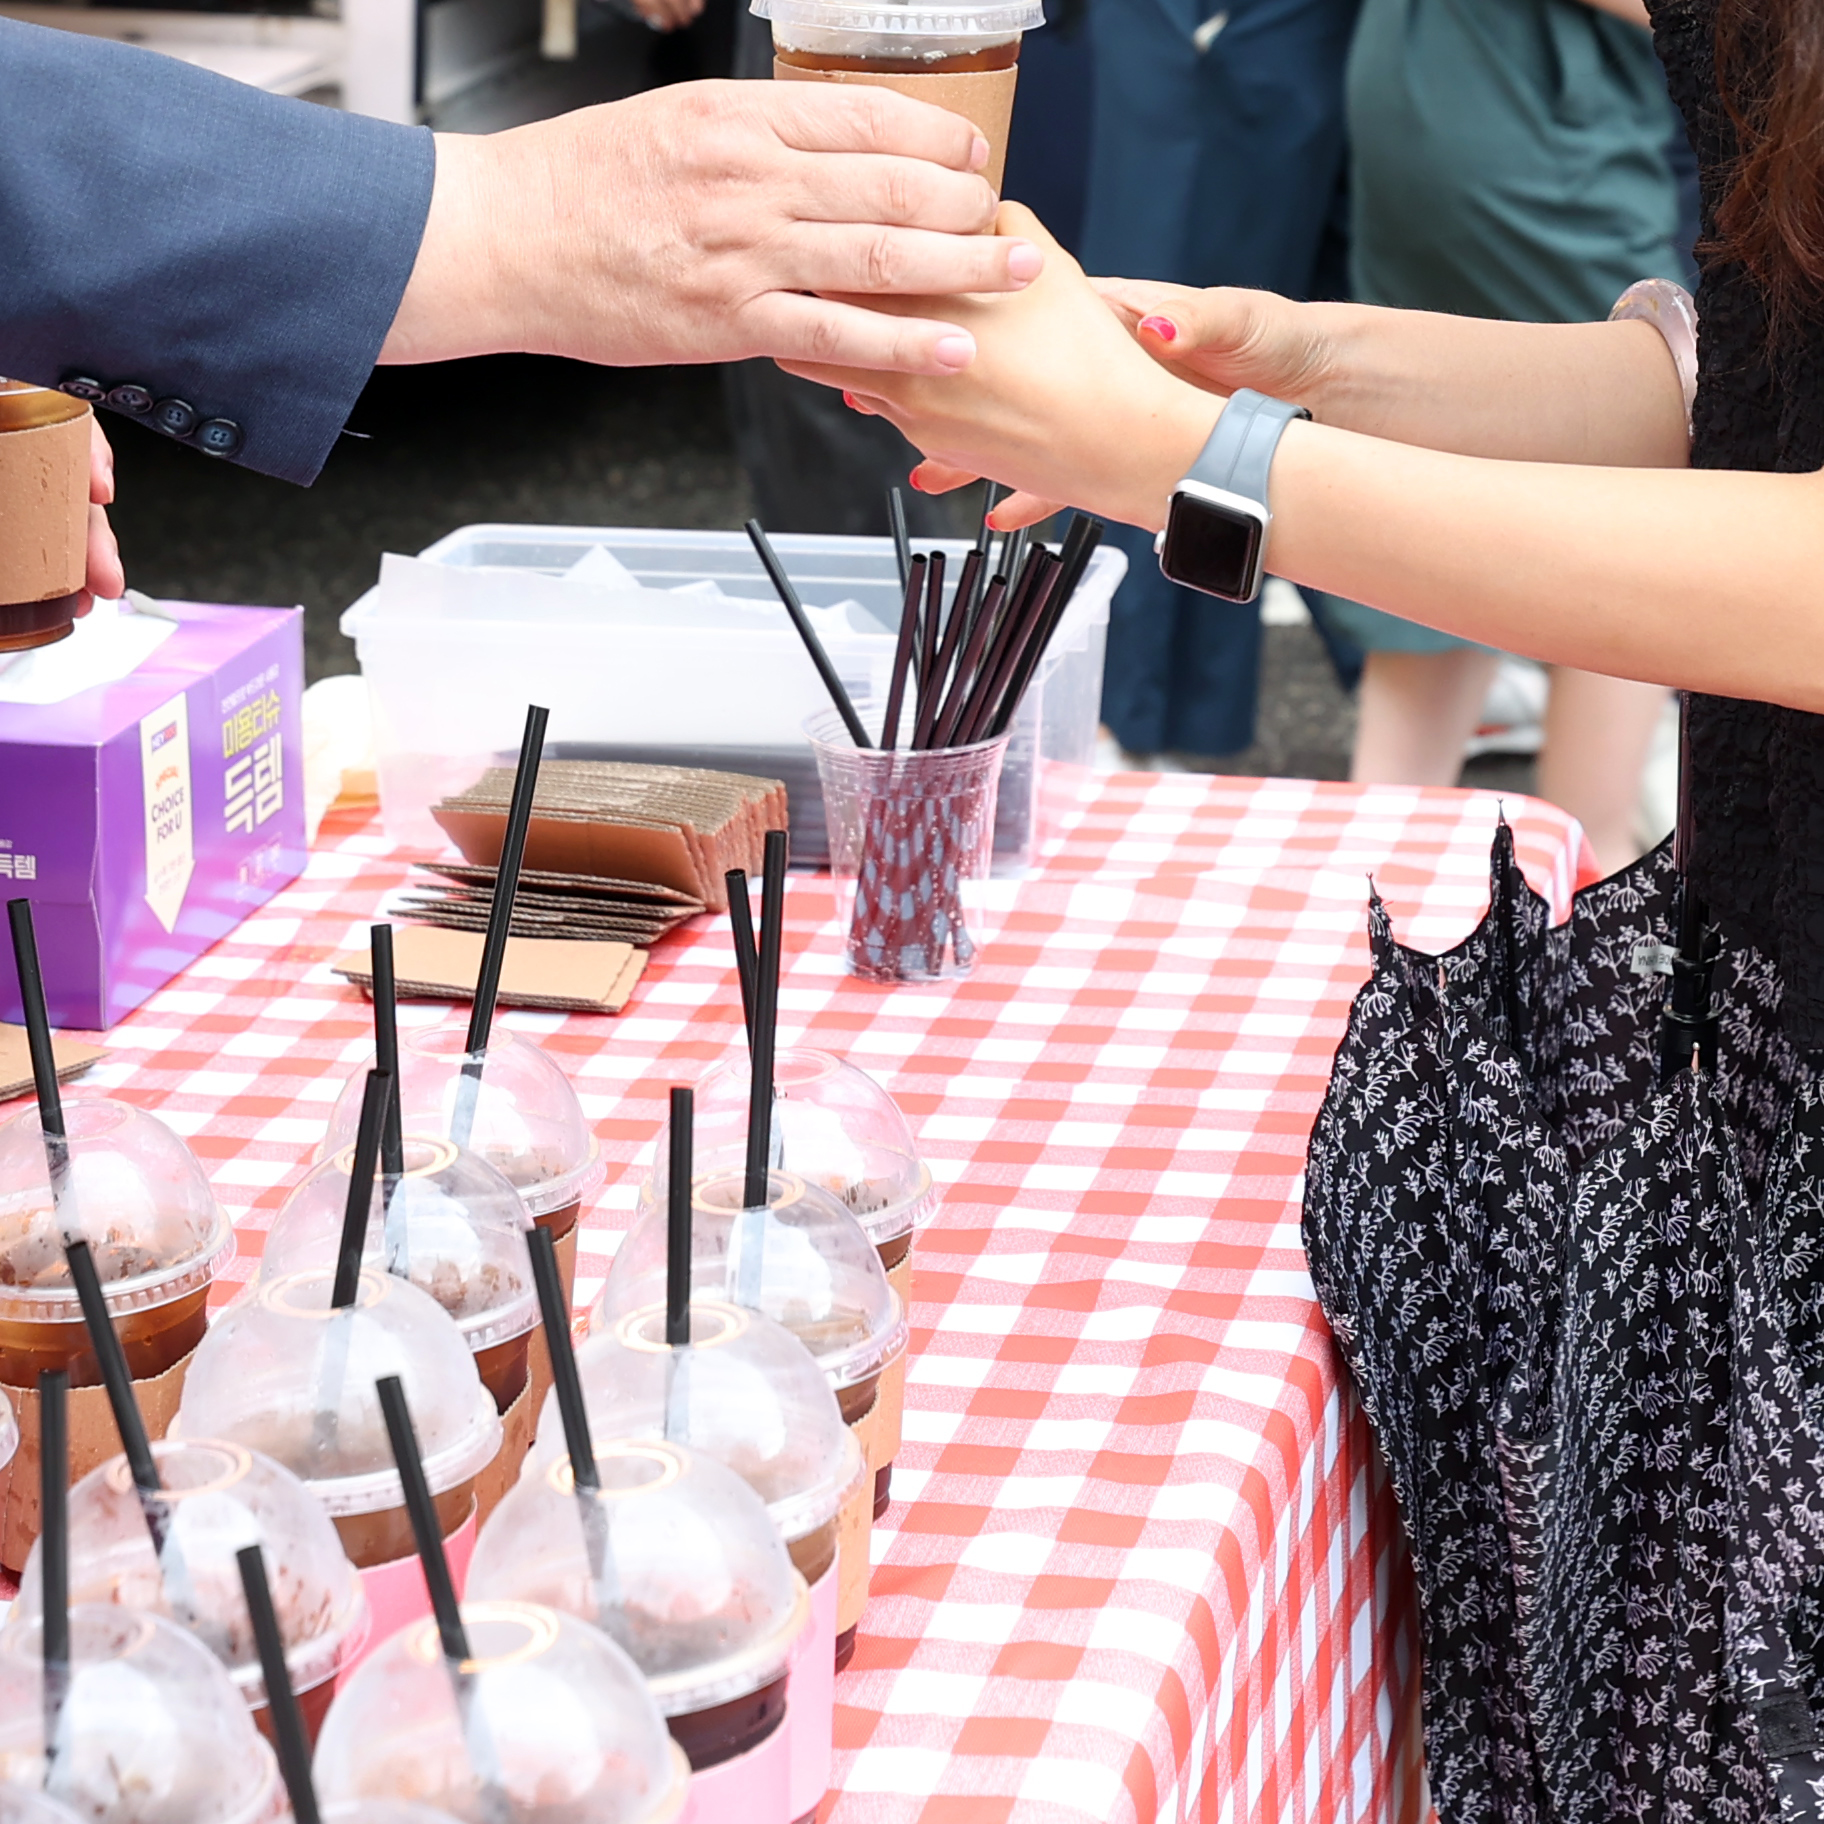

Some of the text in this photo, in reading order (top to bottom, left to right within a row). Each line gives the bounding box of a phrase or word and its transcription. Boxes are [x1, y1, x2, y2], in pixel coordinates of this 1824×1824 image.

[223, 688, 281, 760] 미용티슈
[151, 786, 185, 824] CHOICE
[224, 731, 284, 835] 득템
[156, 810, 183, 845] FOR U
